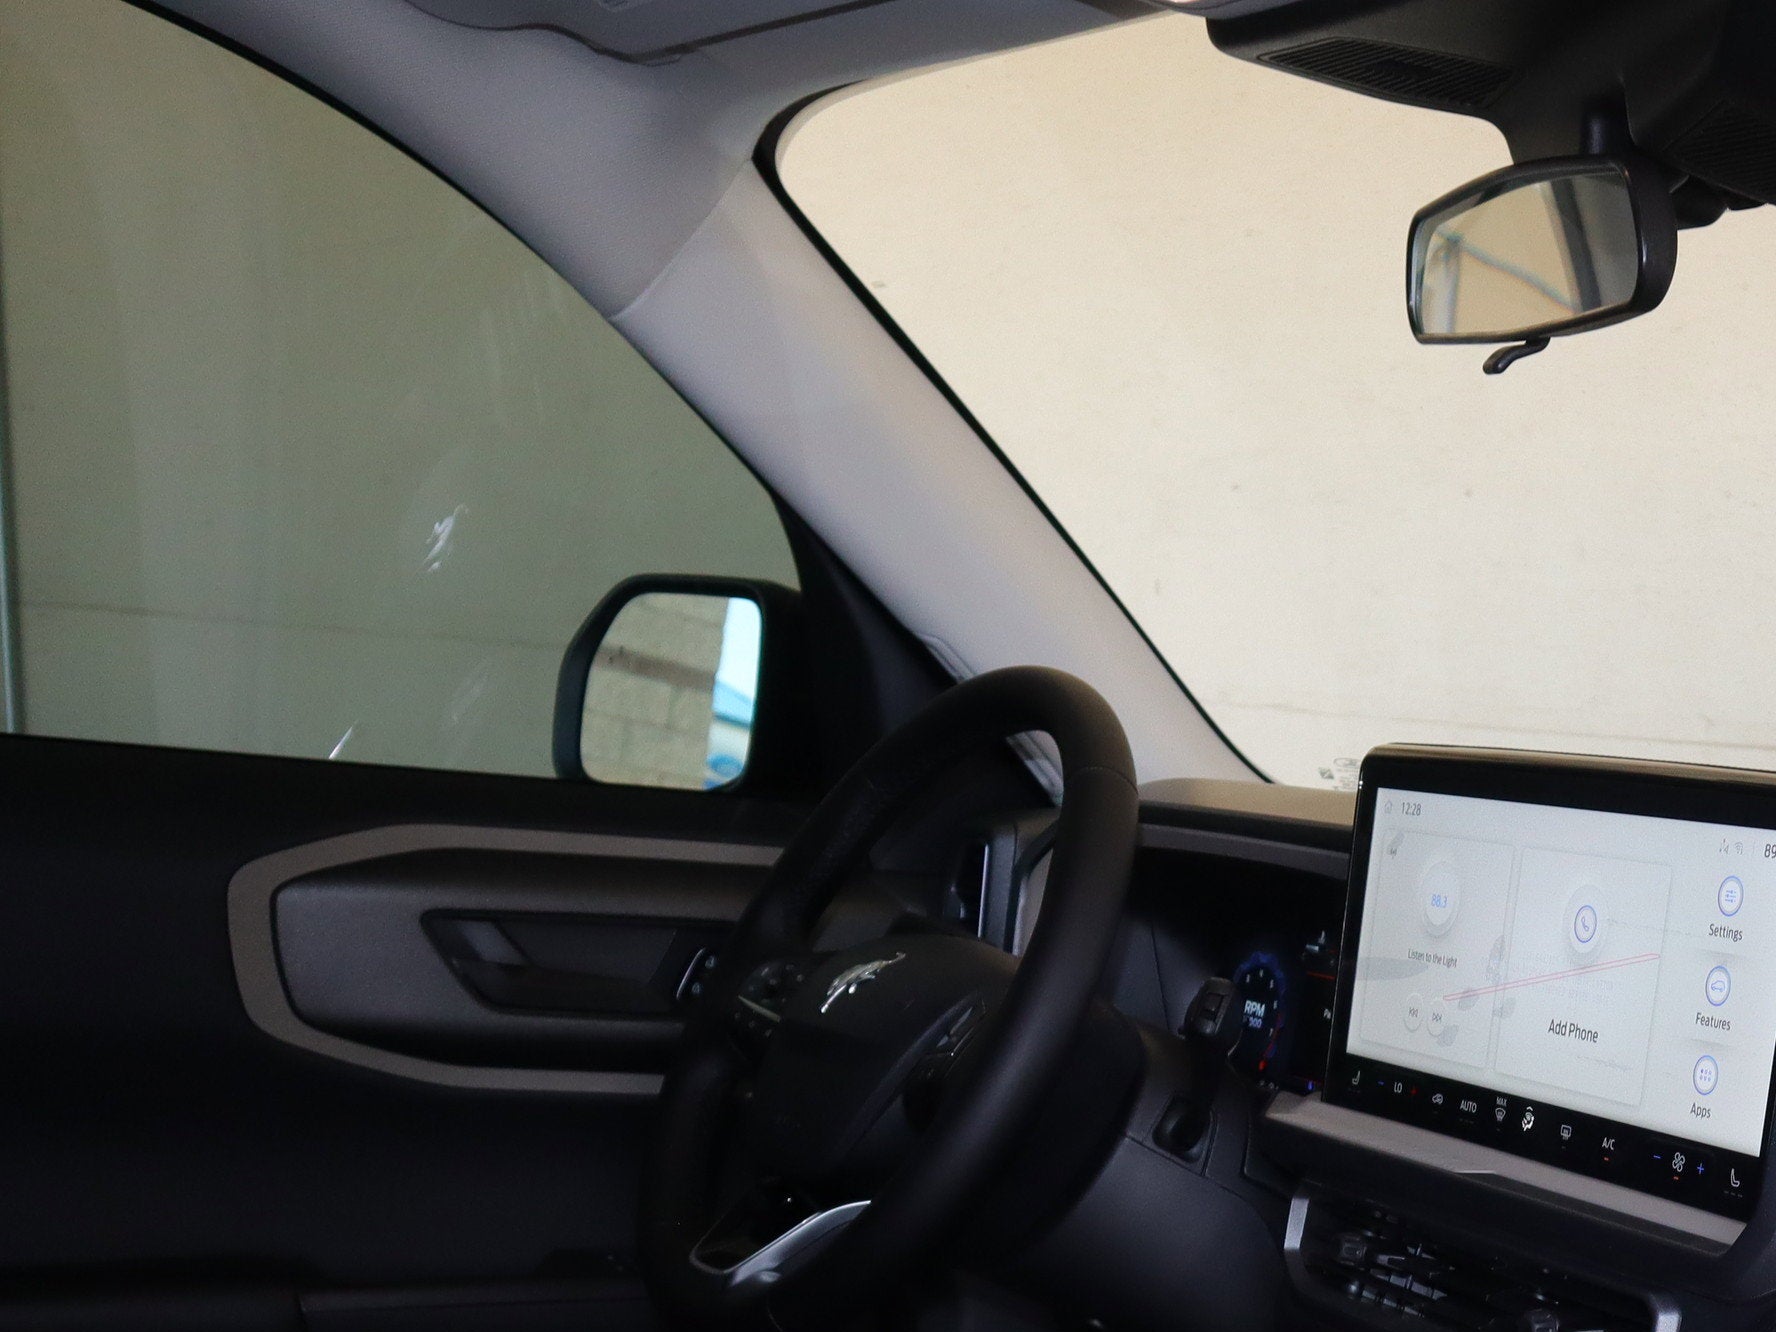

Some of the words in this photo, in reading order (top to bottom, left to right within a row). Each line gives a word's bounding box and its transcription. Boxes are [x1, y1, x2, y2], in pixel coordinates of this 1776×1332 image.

[1401, 802, 1421, 816] 12:28
[1431, 894, 1447, 908] 88.3
[1708, 923, 1743, 942] Settings
[1407, 948, 1425, 961] Listen
[1426, 953, 1432, 963] to
[1433, 953, 1442, 964] the
[1443, 955, 1457, 968] Light
[1244, 1000, 1265, 1017] RPM
[1695, 1012, 1731, 1031] Features
[1548, 1019, 1568, 1037] Add
[1568, 1022, 1599, 1044] Phone
[1393, 1081, 1403, 1094] LO
[1460, 1099, 1477, 1114] AUTO
[1496, 1096, 1508, 1107] MAX
[1690, 1102, 1711, 1119] Apps
[1601, 1136, 1615, 1151] A/C
